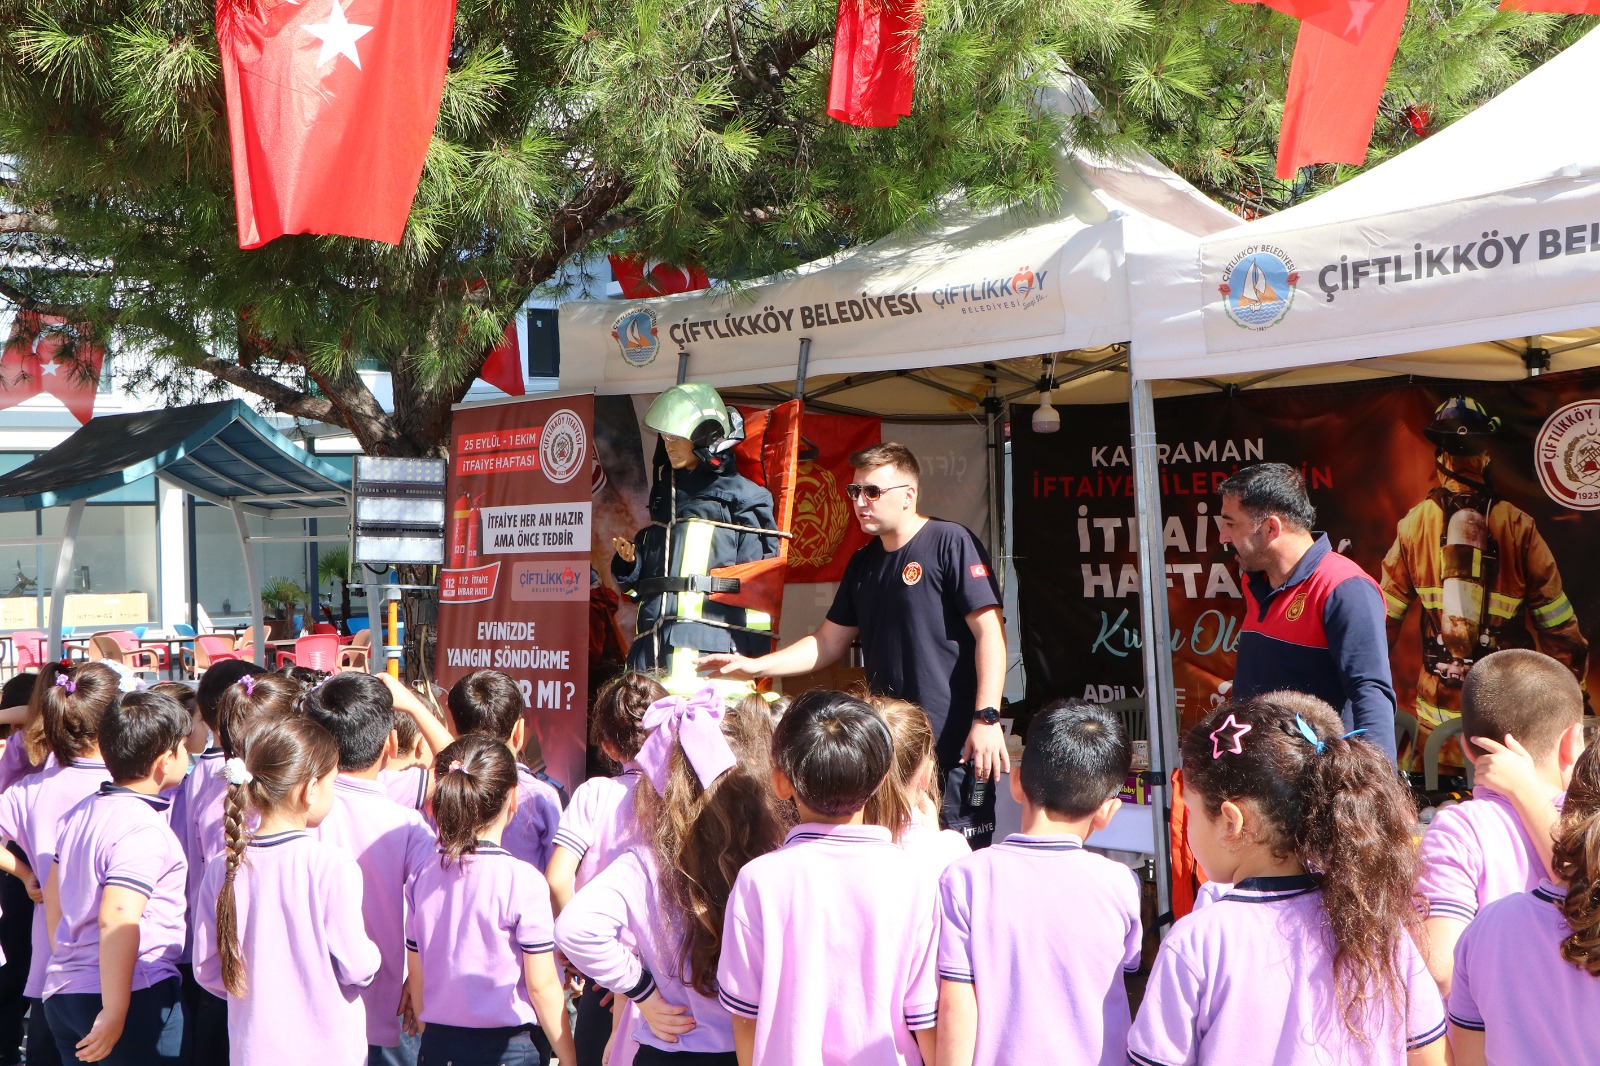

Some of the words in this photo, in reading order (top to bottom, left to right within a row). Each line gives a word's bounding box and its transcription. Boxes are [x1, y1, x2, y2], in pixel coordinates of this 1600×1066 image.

[1222, 244, 1259, 282] ÇİFTLİKKÖY
[1261, 244, 1298, 272] BELEDİYESİ
[1318, 229, 1530, 302] ÇİFTLİKKÖY
[932, 265, 1048, 309] ÇİFTLİKKÖY
[961, 299, 1021, 314] BELEDİYESİ
[669, 305, 794, 350] ÇİFTLİKKÖY
[800, 286, 923, 329] BELEDİYESİ
[464, 440, 474, 451] 25
[475, 435, 501, 450] EYLÜL
[509, 436, 513, 446] 1
[544, 415, 565, 449] ÇİFTLİKKÖY
[1541, 408, 1592, 460] ÇİFTLİKKÖY
[495, 455, 535, 470] HAFTASI
[1091, 437, 1265, 468] KARAMAN
[487, 511, 518, 530] İTFAİYE
[520, 514, 535, 528] HER
[539, 514, 552, 526] AN
[554, 511, 584, 526] HAZIR
[493, 533, 515, 548] AMA
[517, 530, 539, 546] ÖNCE
[542, 529, 573, 546] TEDBİR
[445, 578, 455, 588] 112
[519, 566, 581, 588] ÇİFTLİKKÖY
[477, 621, 536, 641] EVİNİZDE
[447, 648, 491, 667] YANGIN
[494, 645, 570, 670] SÖNDÜRME
[1119, 785, 1136, 794] obby
